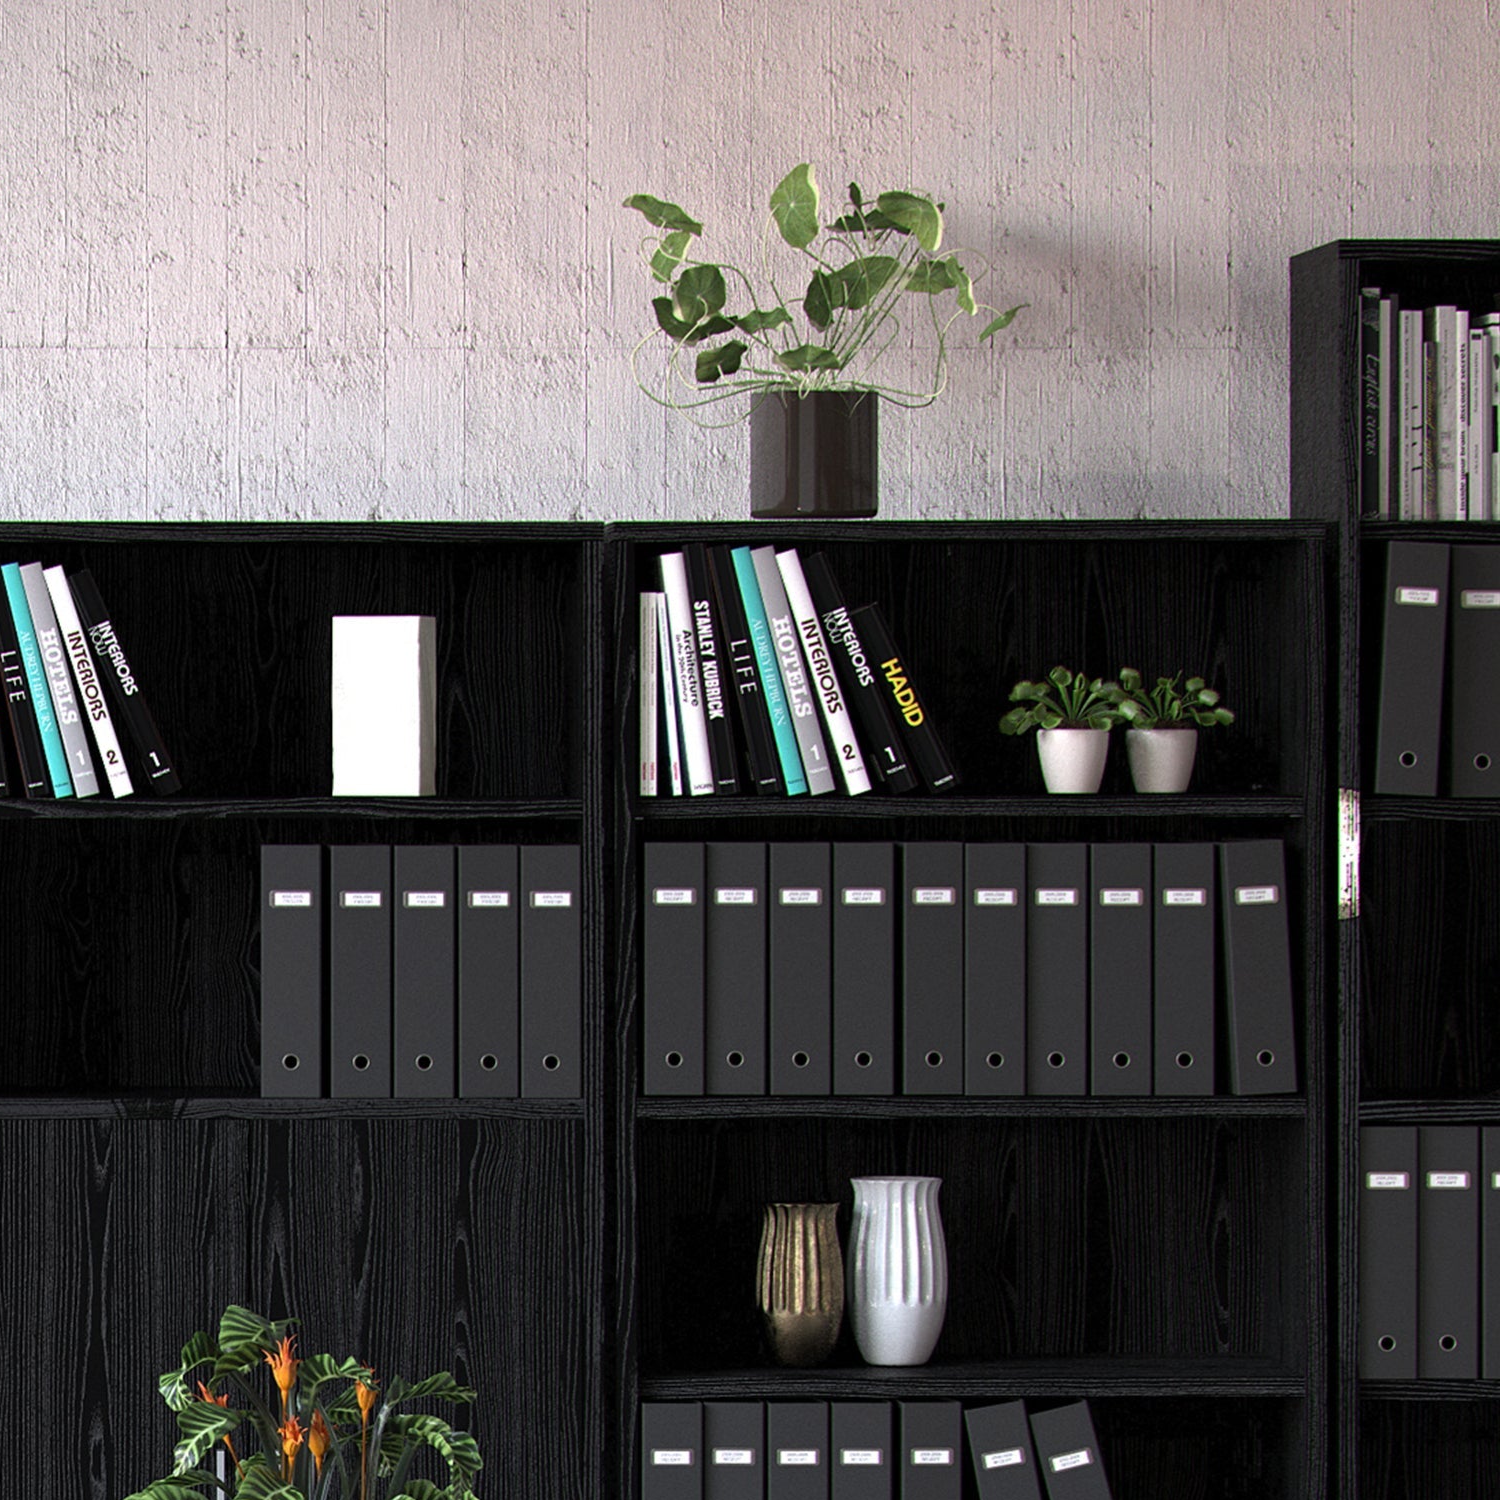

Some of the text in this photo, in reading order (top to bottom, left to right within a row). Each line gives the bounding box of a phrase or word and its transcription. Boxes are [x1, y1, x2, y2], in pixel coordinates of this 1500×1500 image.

[20, 630, 38, 676] AUDREY
[98, 620, 138, 696] INTERIORS
[683, 630, 699, 707] Architecture
[694, 601, 724, 720] STANLEY KUBRICK
[731, 640, 757, 694] LIFE
[752, 618, 771, 665] AUDREY
[772, 615, 813, 718] HOTELS
[801, 618, 844, 714] INTERIORS
[833, 607, 874, 687] INTERIORS
[1, 650, 26, 703] LIFE
[40, 628, 78, 724] HOTELS
[67, 630, 107, 722] INTERIORS
[881, 658, 924, 727] HADID
[76, 750, 85, 766] 1
[106, 750, 118, 765] 2
[150, 752, 161, 768] 1
[810, 744, 820, 761] 1
[842, 744, 855, 760] 2
[884, 746, 896, 763] 1
